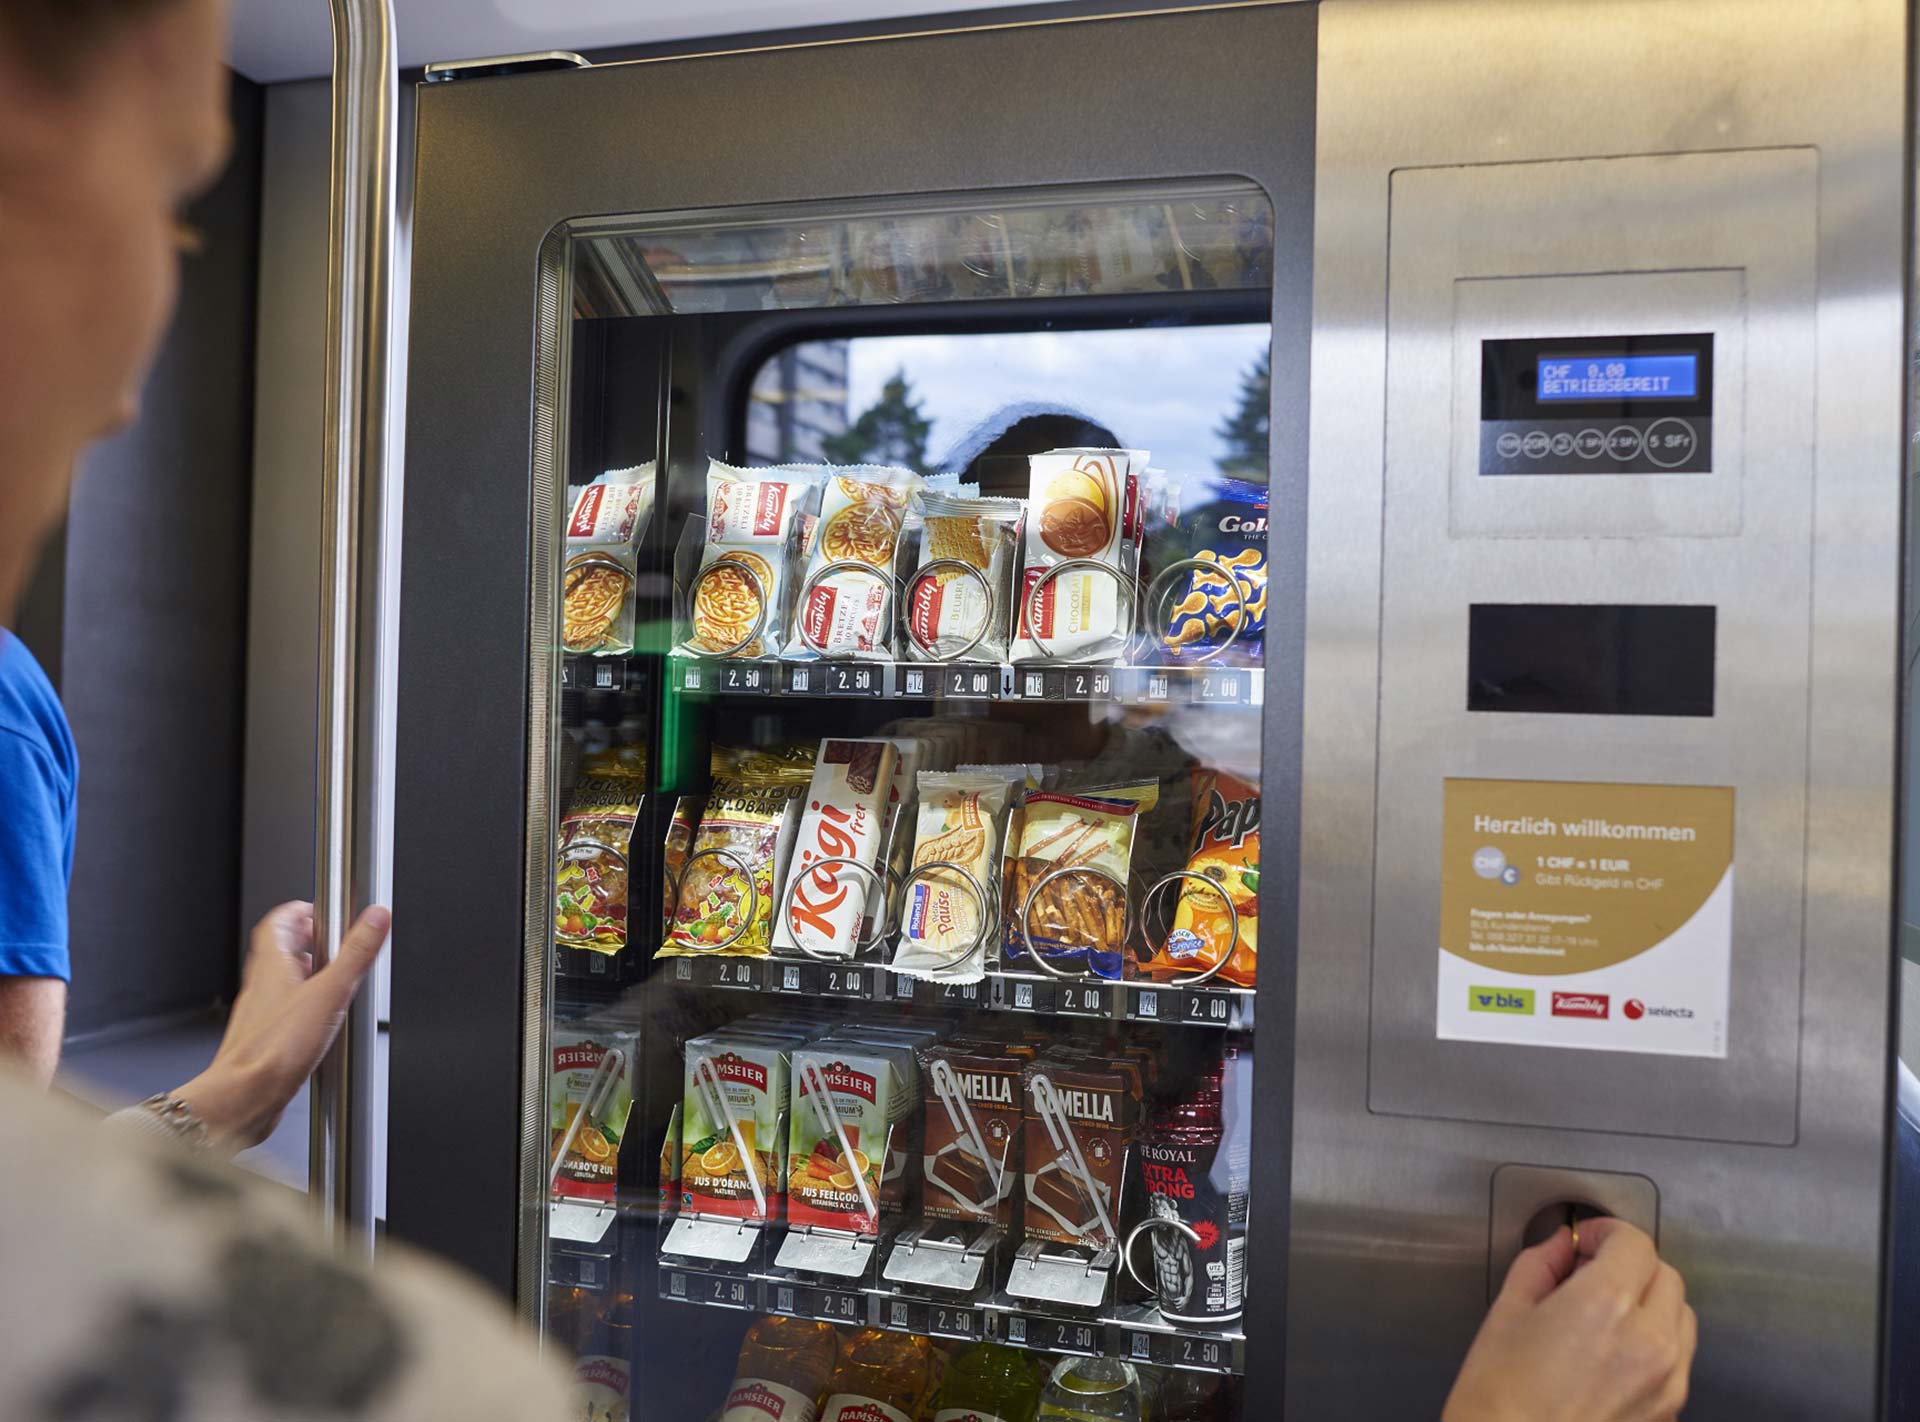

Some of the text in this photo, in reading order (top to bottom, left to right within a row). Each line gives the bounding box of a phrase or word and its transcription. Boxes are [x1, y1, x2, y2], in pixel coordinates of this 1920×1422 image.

[1544, 363, 1626, 378] CHF 0.00
[1544, 376, 1671, 394] BETRIEBSBEREIT
[1649, 435, 1691, 449] 5 SFr
[758, 484, 782, 532] Kambly
[809, 591, 831, 643] Kambly
[833, 594, 851, 645] BRETZEI
[848, 802, 867, 836] fret
[1473, 814, 1697, 841] Herzlich willkommen
[791, 801, 857, 940] Kägi
[1537, 856, 1544, 868] 1
[1547, 857, 1575, 870] CHF
[1589, 859, 1597, 870] 1
[1600, 859, 1631, 872] EUR
[1636, 878, 1665, 891] CHF
[911, 903, 922, 930] Roland
[937, 890, 954, 937] Pause
[1495, 992, 1523, 1009] bls
[1647, 1006, 1694, 1019] selecta
[701, 1063, 764, 1084] RMSEIER
[813, 1074, 872, 1094] MSEIER
[1151, 1148, 1197, 1163] ROYAL
[694, 1176, 753, 1191] JUS D'ORAN
[802, 1187, 817, 1197] JUS
[1145, 1178, 1196, 1200] TRONG
[840, 1411, 887, 1422] RAMSE
